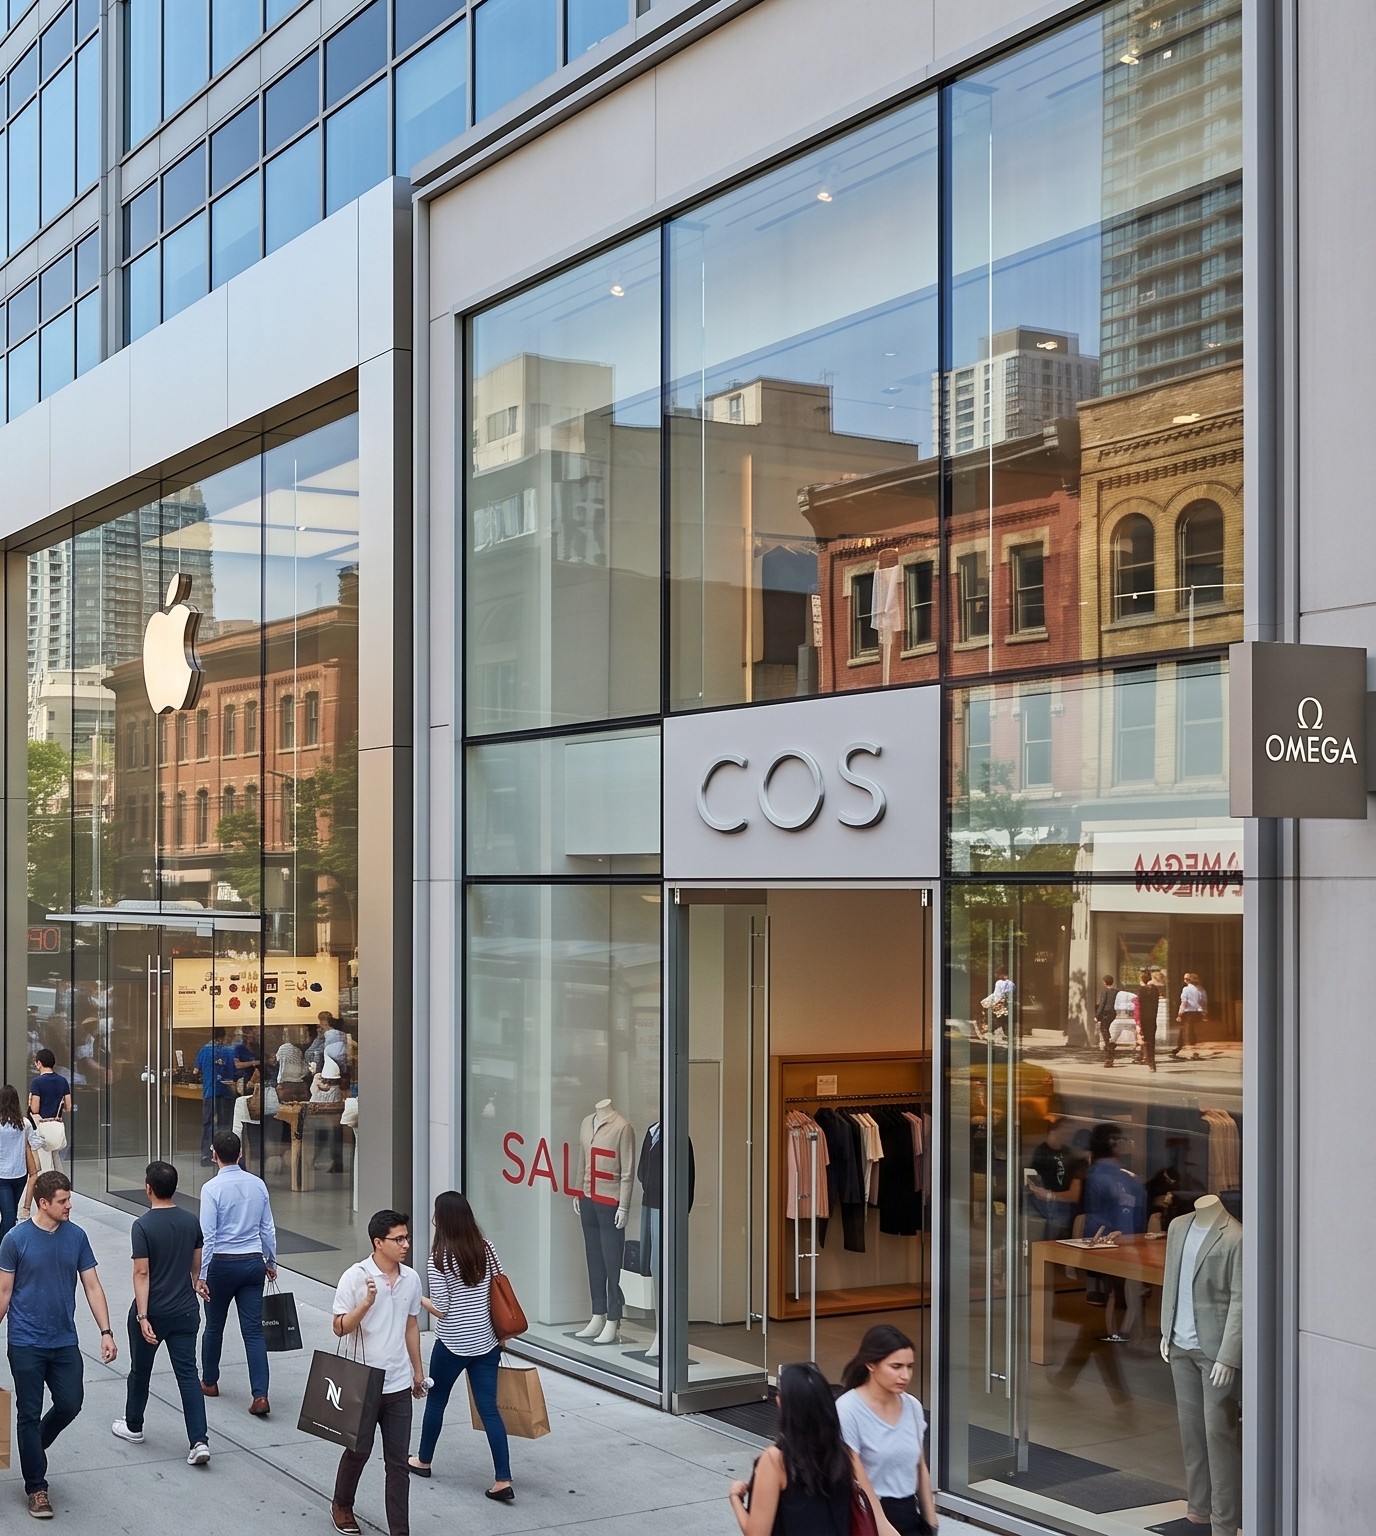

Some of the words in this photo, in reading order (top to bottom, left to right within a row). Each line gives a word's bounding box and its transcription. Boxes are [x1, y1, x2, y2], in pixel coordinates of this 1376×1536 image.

[1265, 734, 1358, 764] OMEGA
[696, 740, 887, 834] COS
[502, 1131, 618, 1206] SALE
[324, 1377, 344, 1411] N
